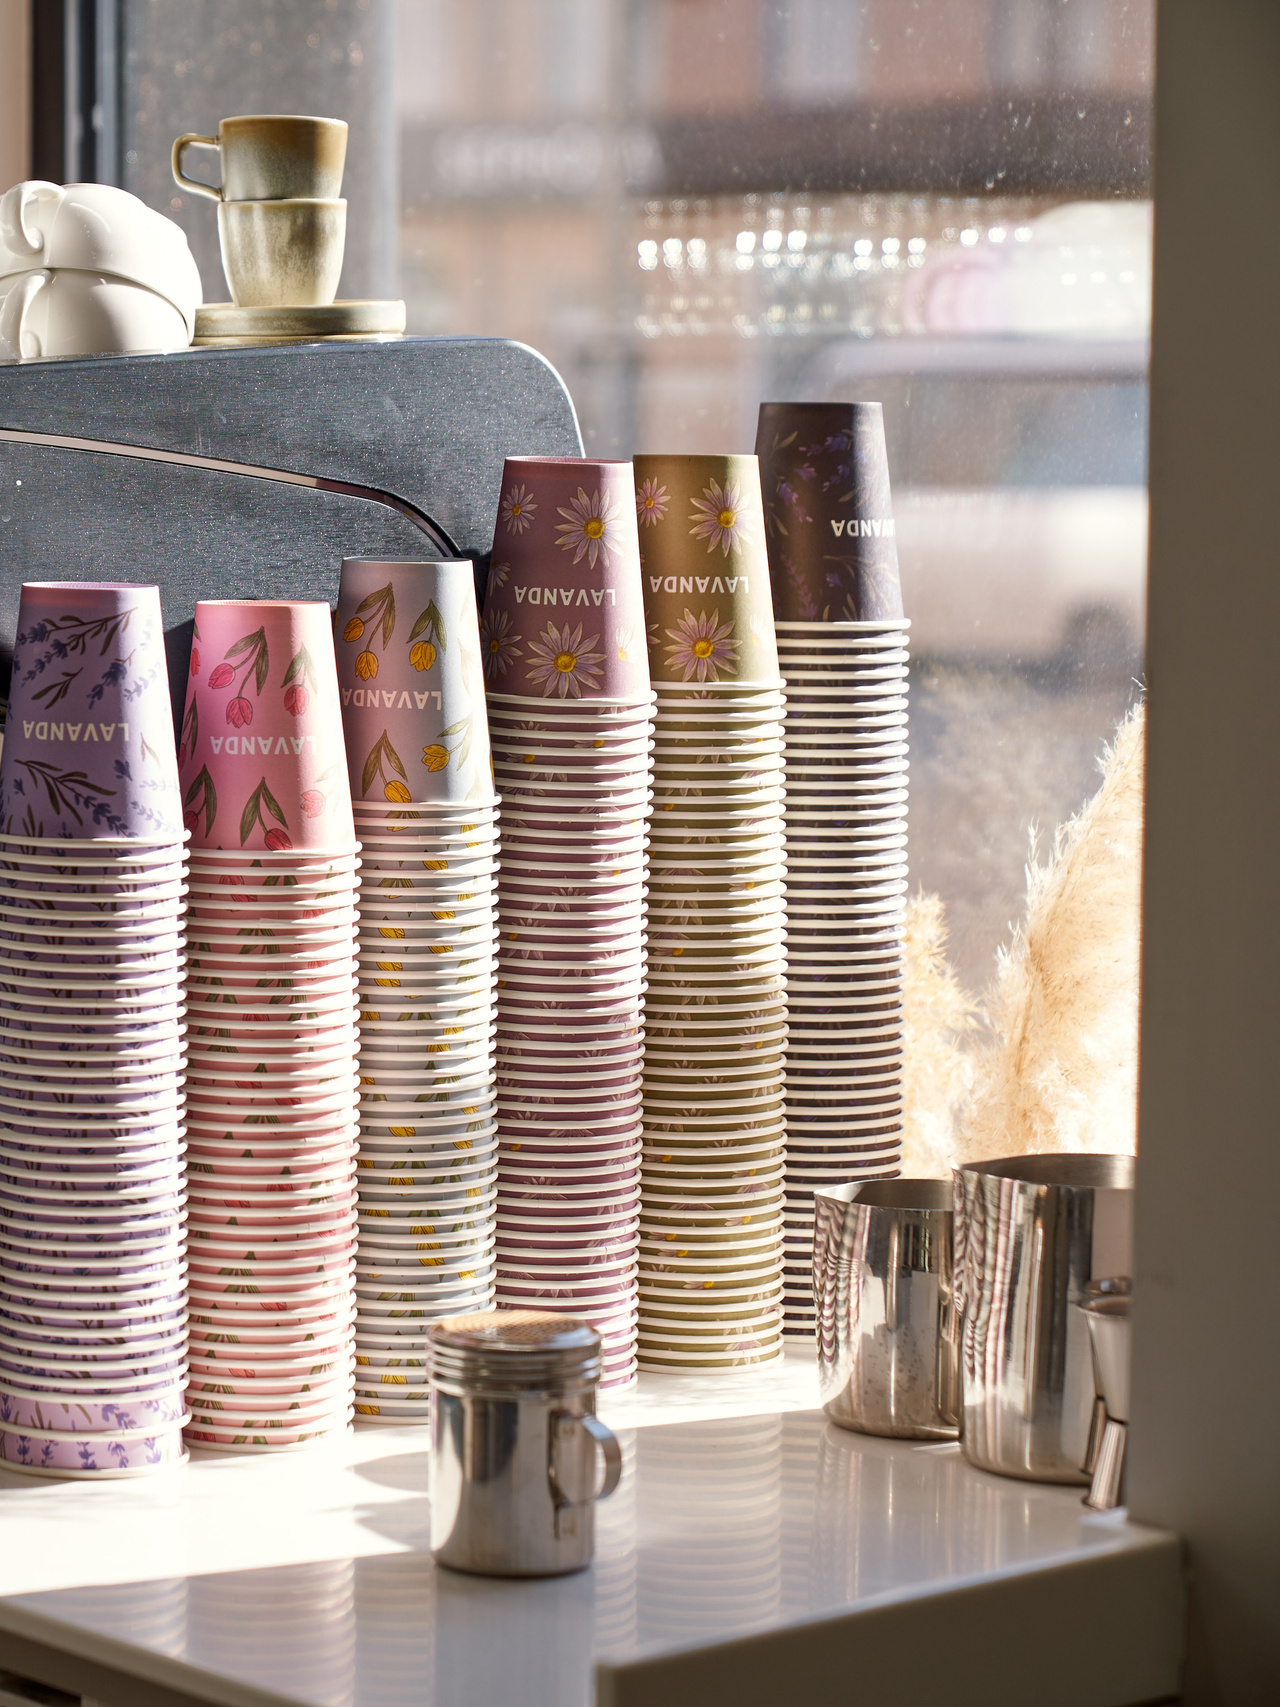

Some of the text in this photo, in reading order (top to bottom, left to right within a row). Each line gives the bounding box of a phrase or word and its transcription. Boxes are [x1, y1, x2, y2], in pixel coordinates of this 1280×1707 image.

[650, 575, 750, 594] LAVANDA
[514, 585, 616, 607] LAVANDA
[341, 683, 442, 711] LAVANDA
[22, 720, 130, 742] LAVANDA
[210, 736, 318, 755] LAVANDA
